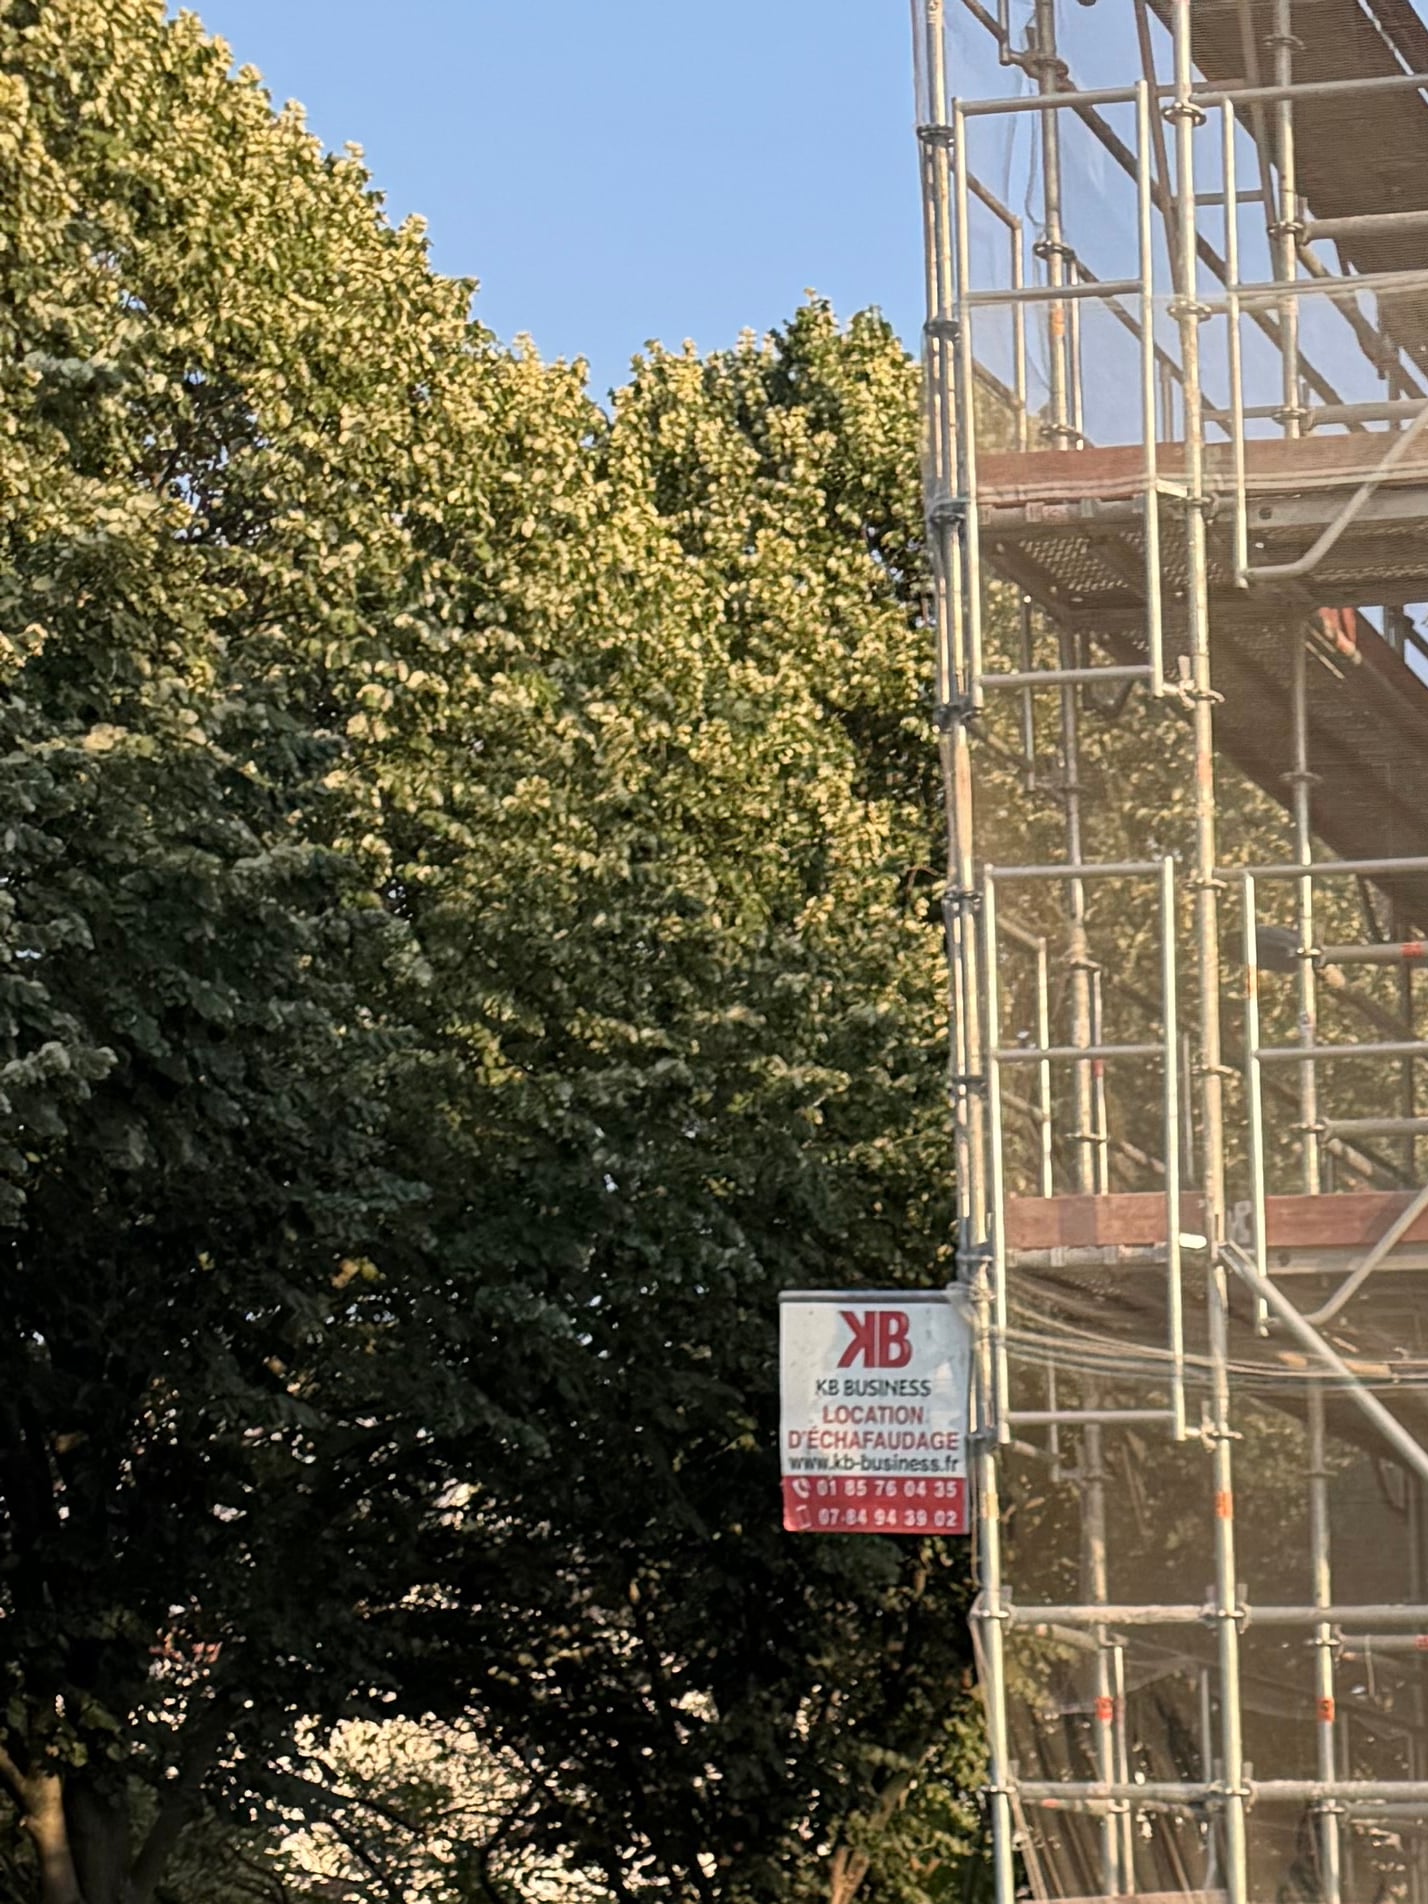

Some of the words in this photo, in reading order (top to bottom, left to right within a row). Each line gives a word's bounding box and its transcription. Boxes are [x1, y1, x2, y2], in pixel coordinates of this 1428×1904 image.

[837, 1310, 913, 1368] KB
[815, 1379, 839, 1396] KB
[843, 1379, 932, 1397] BUSINESS
[822, 1404, 924, 1425] LOCATION
[788, 1426, 960, 1450] D'ÉCHAFAUDAGE
[788, 1453, 959, 1473] www.kb-business.fr
[816, 1478, 837, 1497] 01
[903, 1480, 927, 1498] 04
[934, 1480, 957, 1499] 35
[818, 1507, 840, 1526] 07
[934, 1510, 957, 1528] 02
